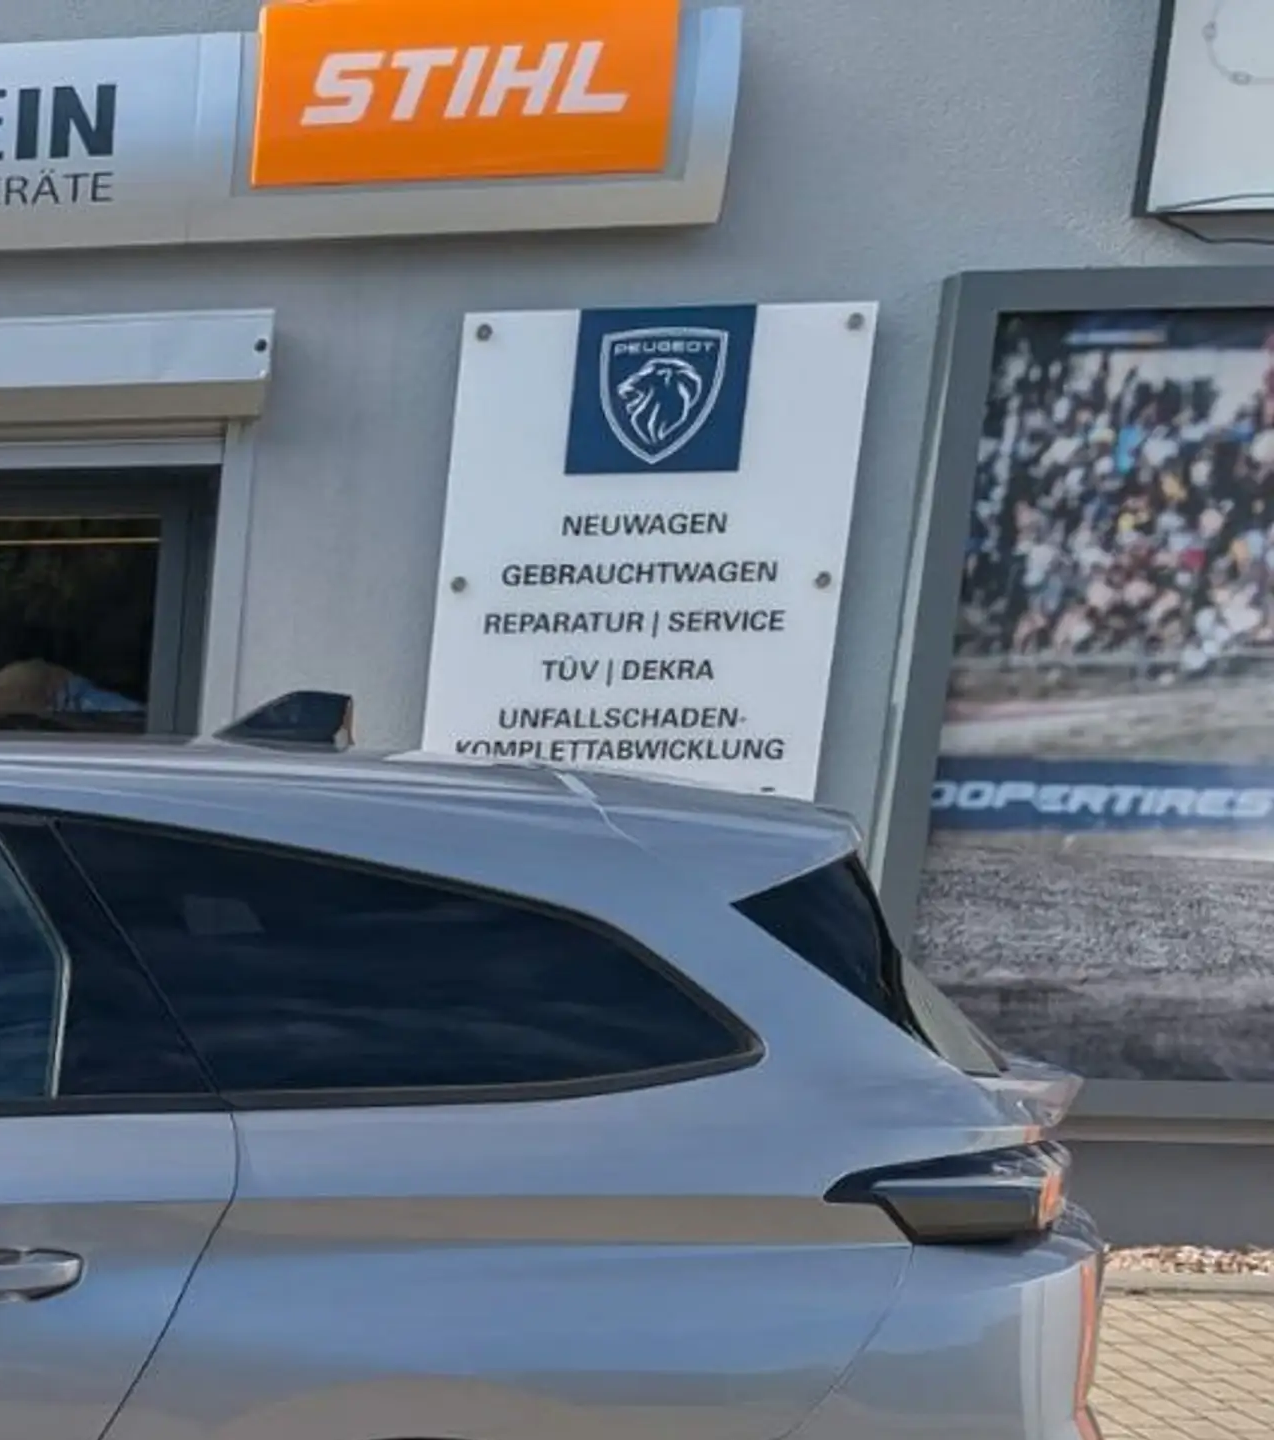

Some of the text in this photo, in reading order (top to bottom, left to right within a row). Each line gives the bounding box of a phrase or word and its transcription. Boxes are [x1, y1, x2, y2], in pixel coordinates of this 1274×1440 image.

[300, 40, 629, 126] STIHL
[613, 341, 715, 355] PEUGEOT
[561, 513, 728, 536] NEUWAGEN
[501, 561, 778, 587] GEBRAUCHTWAGEN
[483, 611, 644, 634] REPARATUR
[668, 609, 786, 632] SERVICE
[541, 655, 599, 681] TÜV
[621, 660, 714, 681] DEKRA
[498, 707, 747, 730] UNFALLSCHADEN-
